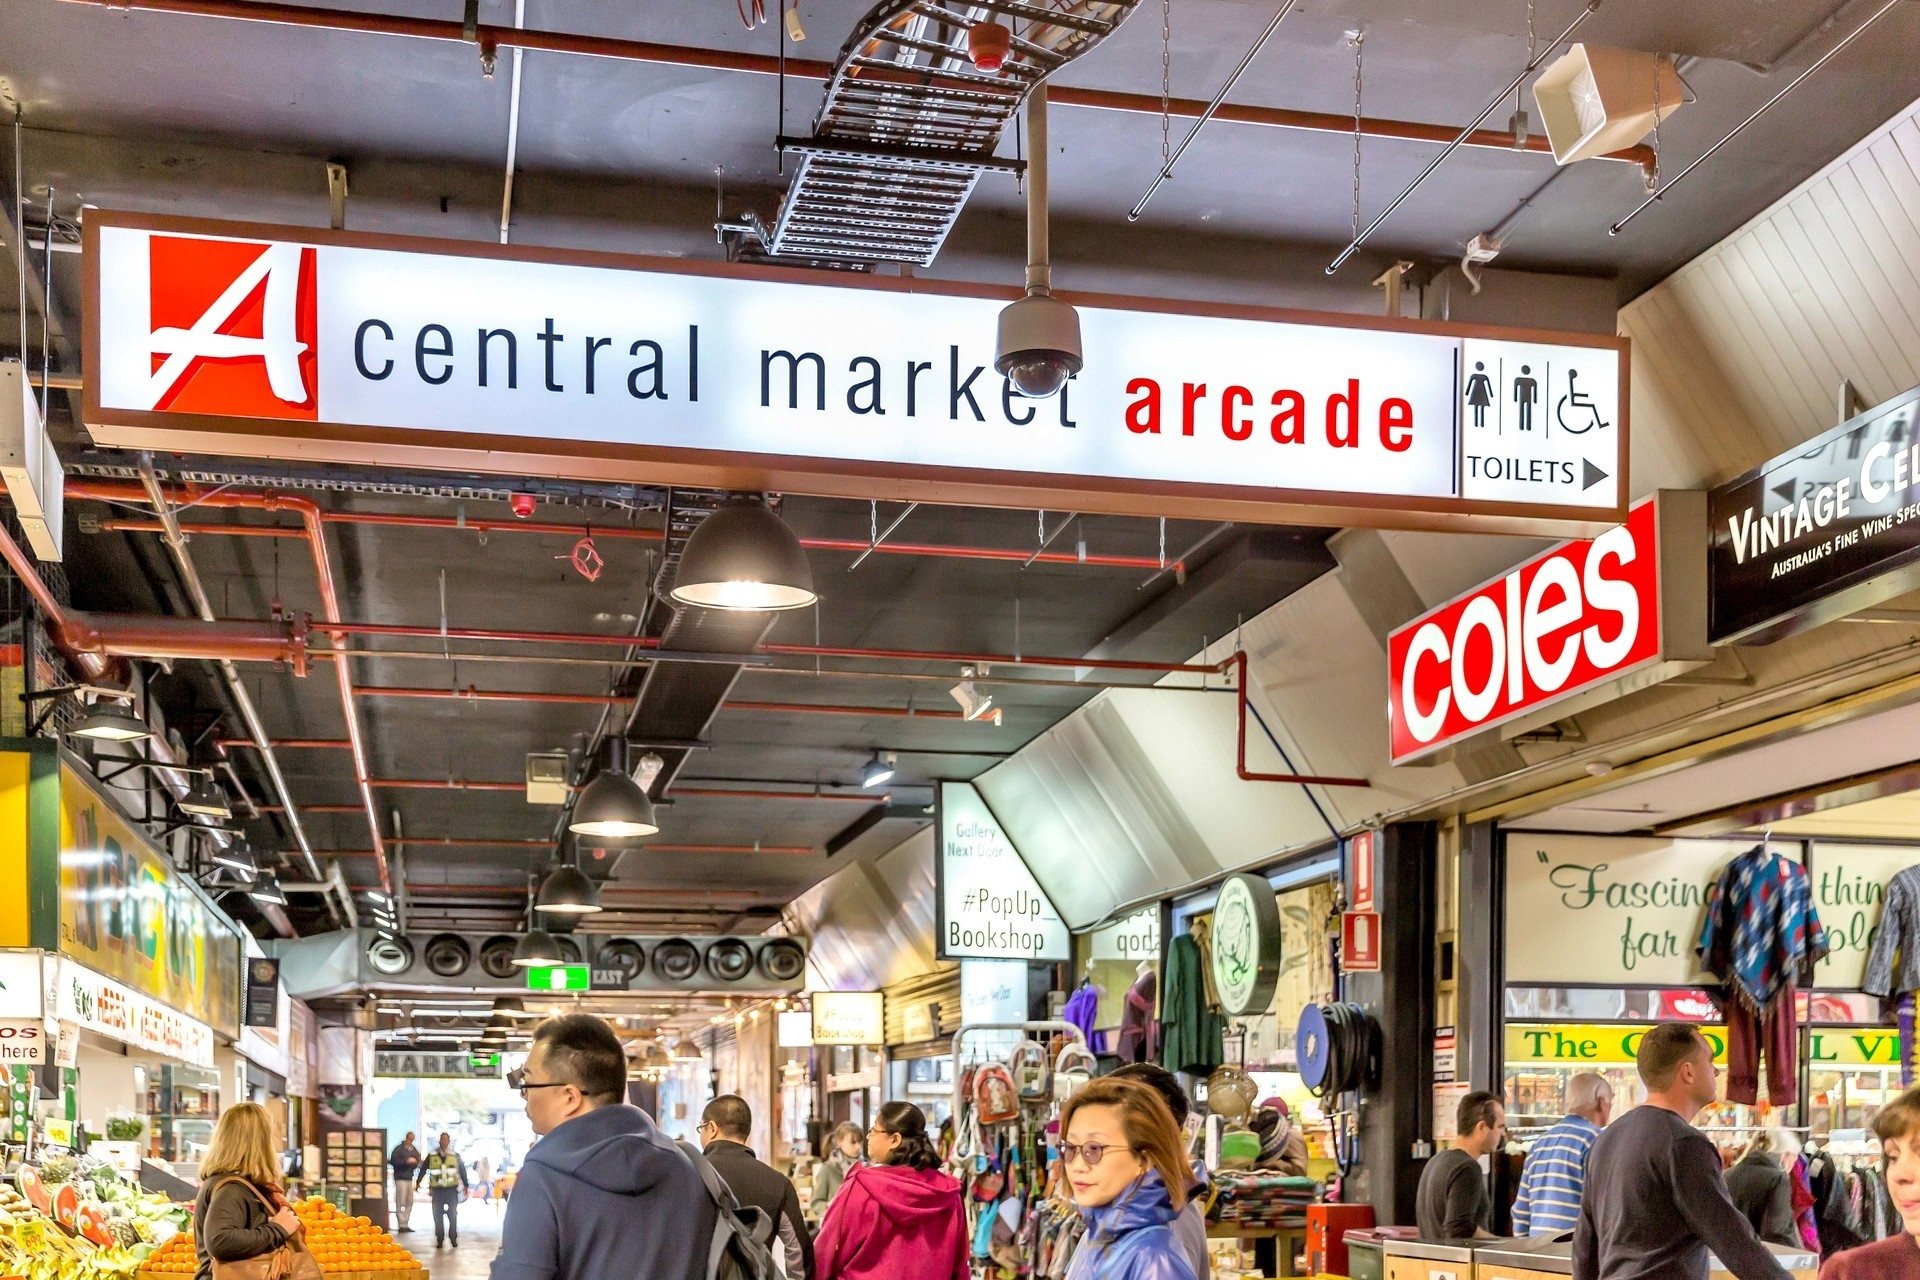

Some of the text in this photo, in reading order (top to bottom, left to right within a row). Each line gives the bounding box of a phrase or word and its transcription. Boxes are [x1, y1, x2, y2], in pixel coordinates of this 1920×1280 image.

[354, 318, 699, 402] central
[1125, 378, 1413, 452] arcade
[1466, 455, 1574, 485] TOILETS
[1402, 525, 1640, 743] coles
[956, 822, 996, 842] Gallery
[947, 842, 1003, 858] Next Door
[949, 921, 1044, 958] Bookshop
[2, 1043, 38, 1058] here
[1524, 1031, 1598, 1058] The
